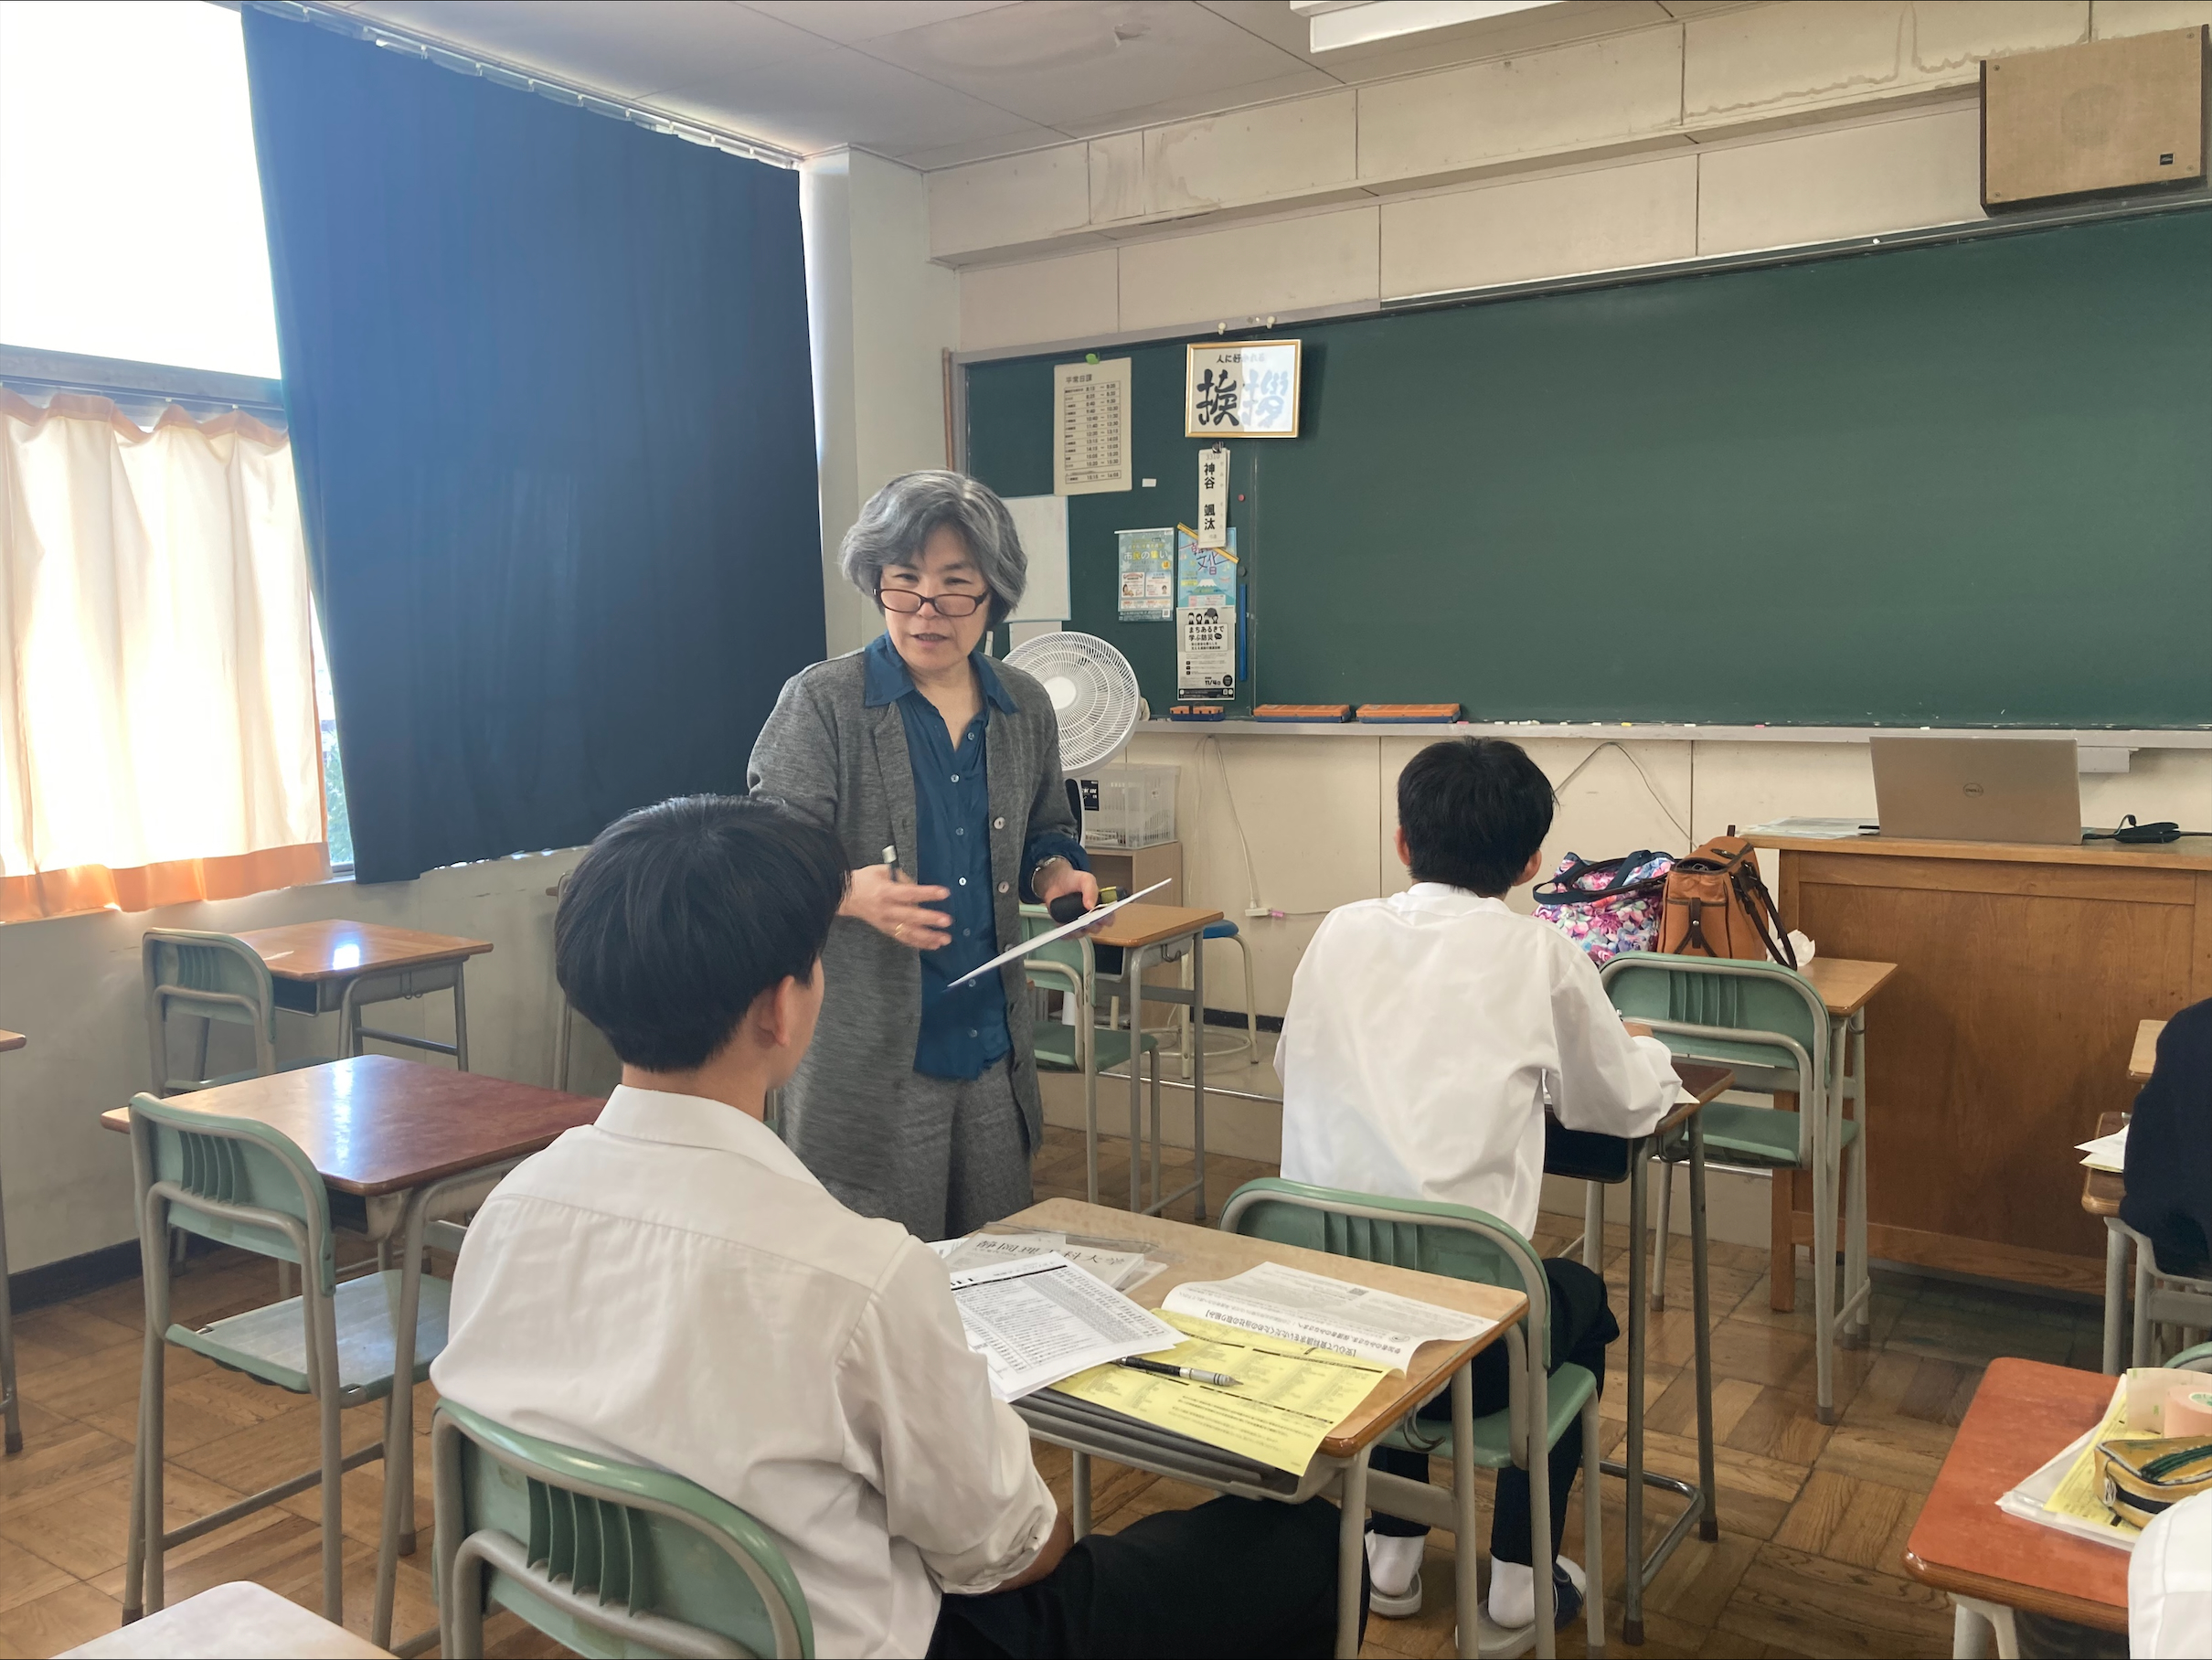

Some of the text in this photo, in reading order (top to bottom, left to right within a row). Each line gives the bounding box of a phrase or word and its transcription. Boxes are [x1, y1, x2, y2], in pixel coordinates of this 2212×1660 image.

[1196, 368, 1289, 429] 挨拶
[1204, 463, 1215, 489] 神谷
[1204, 504, 1215, 530] 颯汰
[1188, 633, 1213, 642] 学ぶ防災
[1189, 625, 1224, 633] まちあるきで
